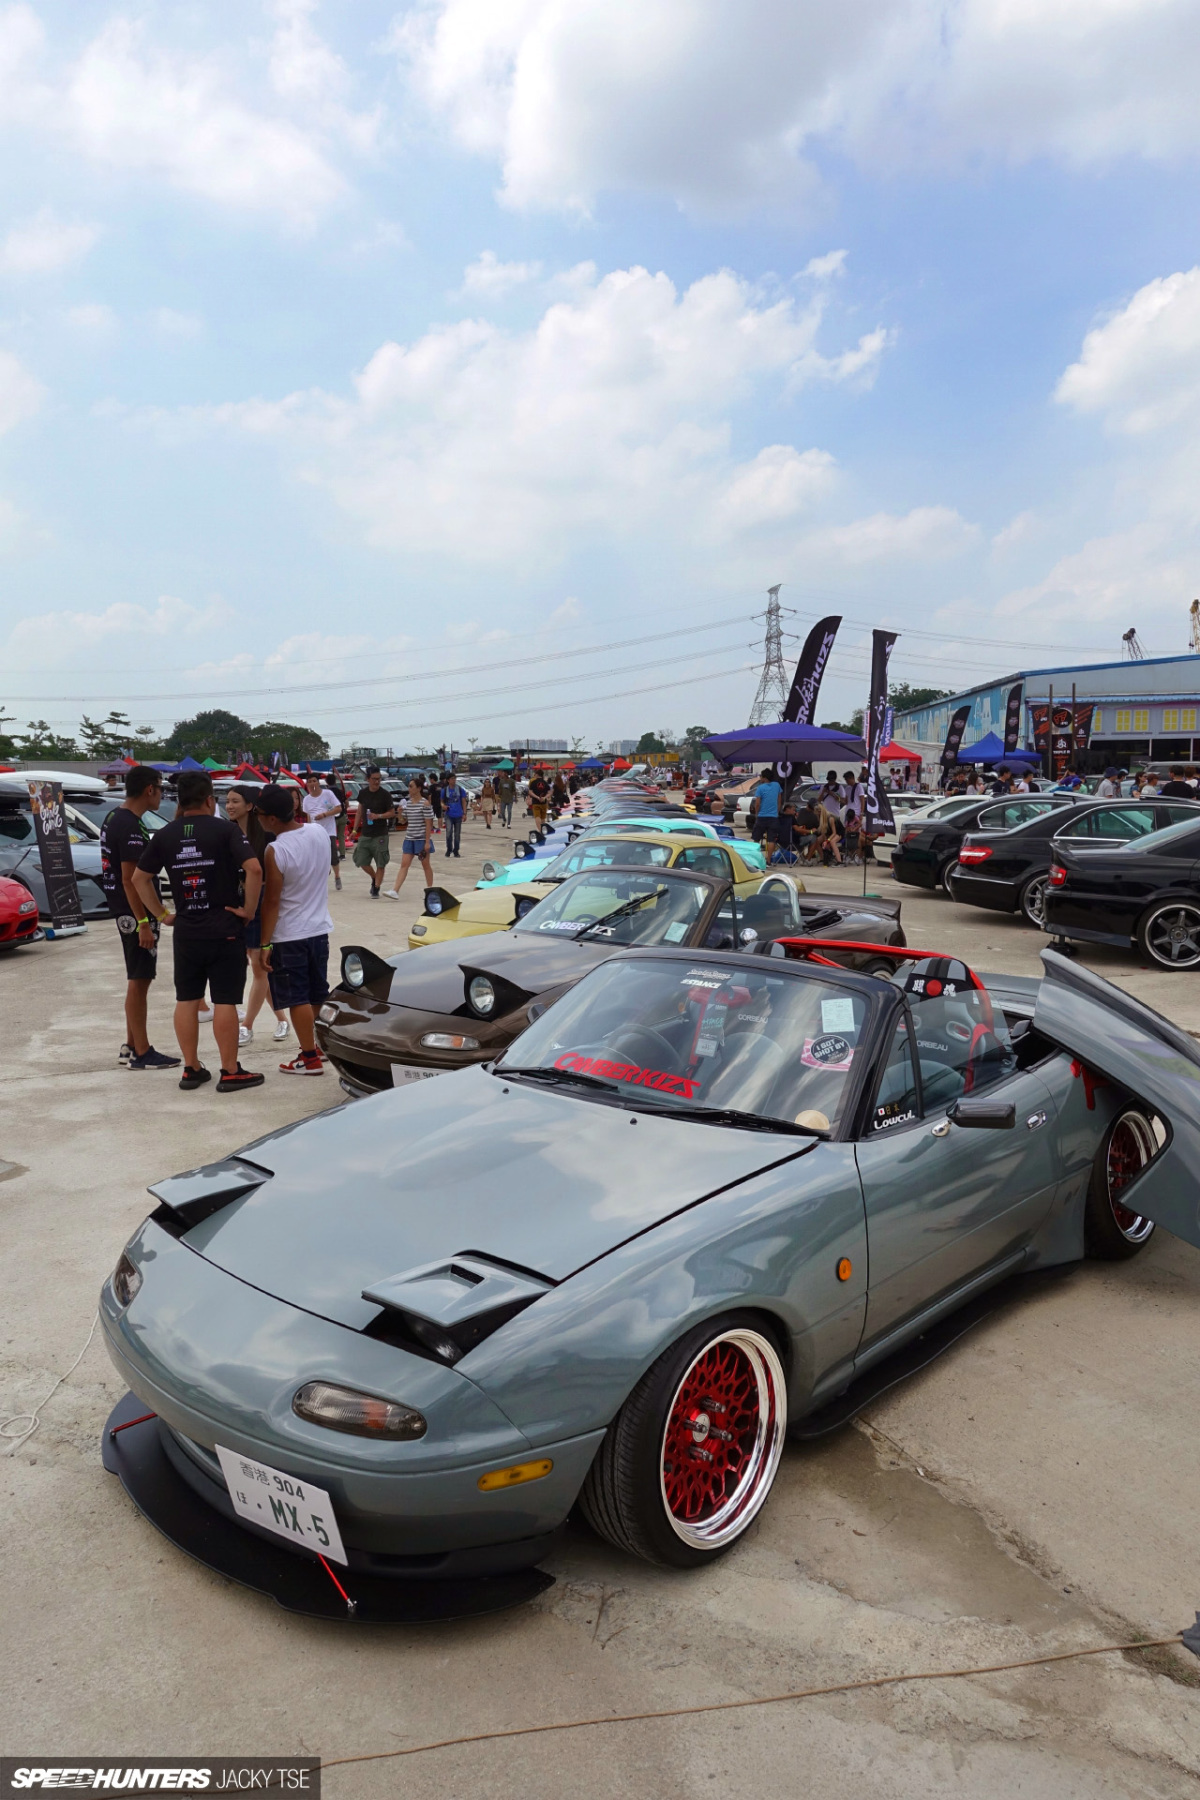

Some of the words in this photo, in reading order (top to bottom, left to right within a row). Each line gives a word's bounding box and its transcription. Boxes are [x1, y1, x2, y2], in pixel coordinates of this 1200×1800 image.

[738, 1014, 768, 1024] CORBEAU
[814, 1045, 834, 1058] SHOT
[835, 1041, 845, 1050] BY
[821, 1039, 835, 1048] GOT
[917, 1040, 948, 1052] ORBEAU
[554, 1052, 701, 1099] CAMBERKIZS
[239, 1461, 270, 1486] 香港
[272, 1475, 305, 1502] 904
